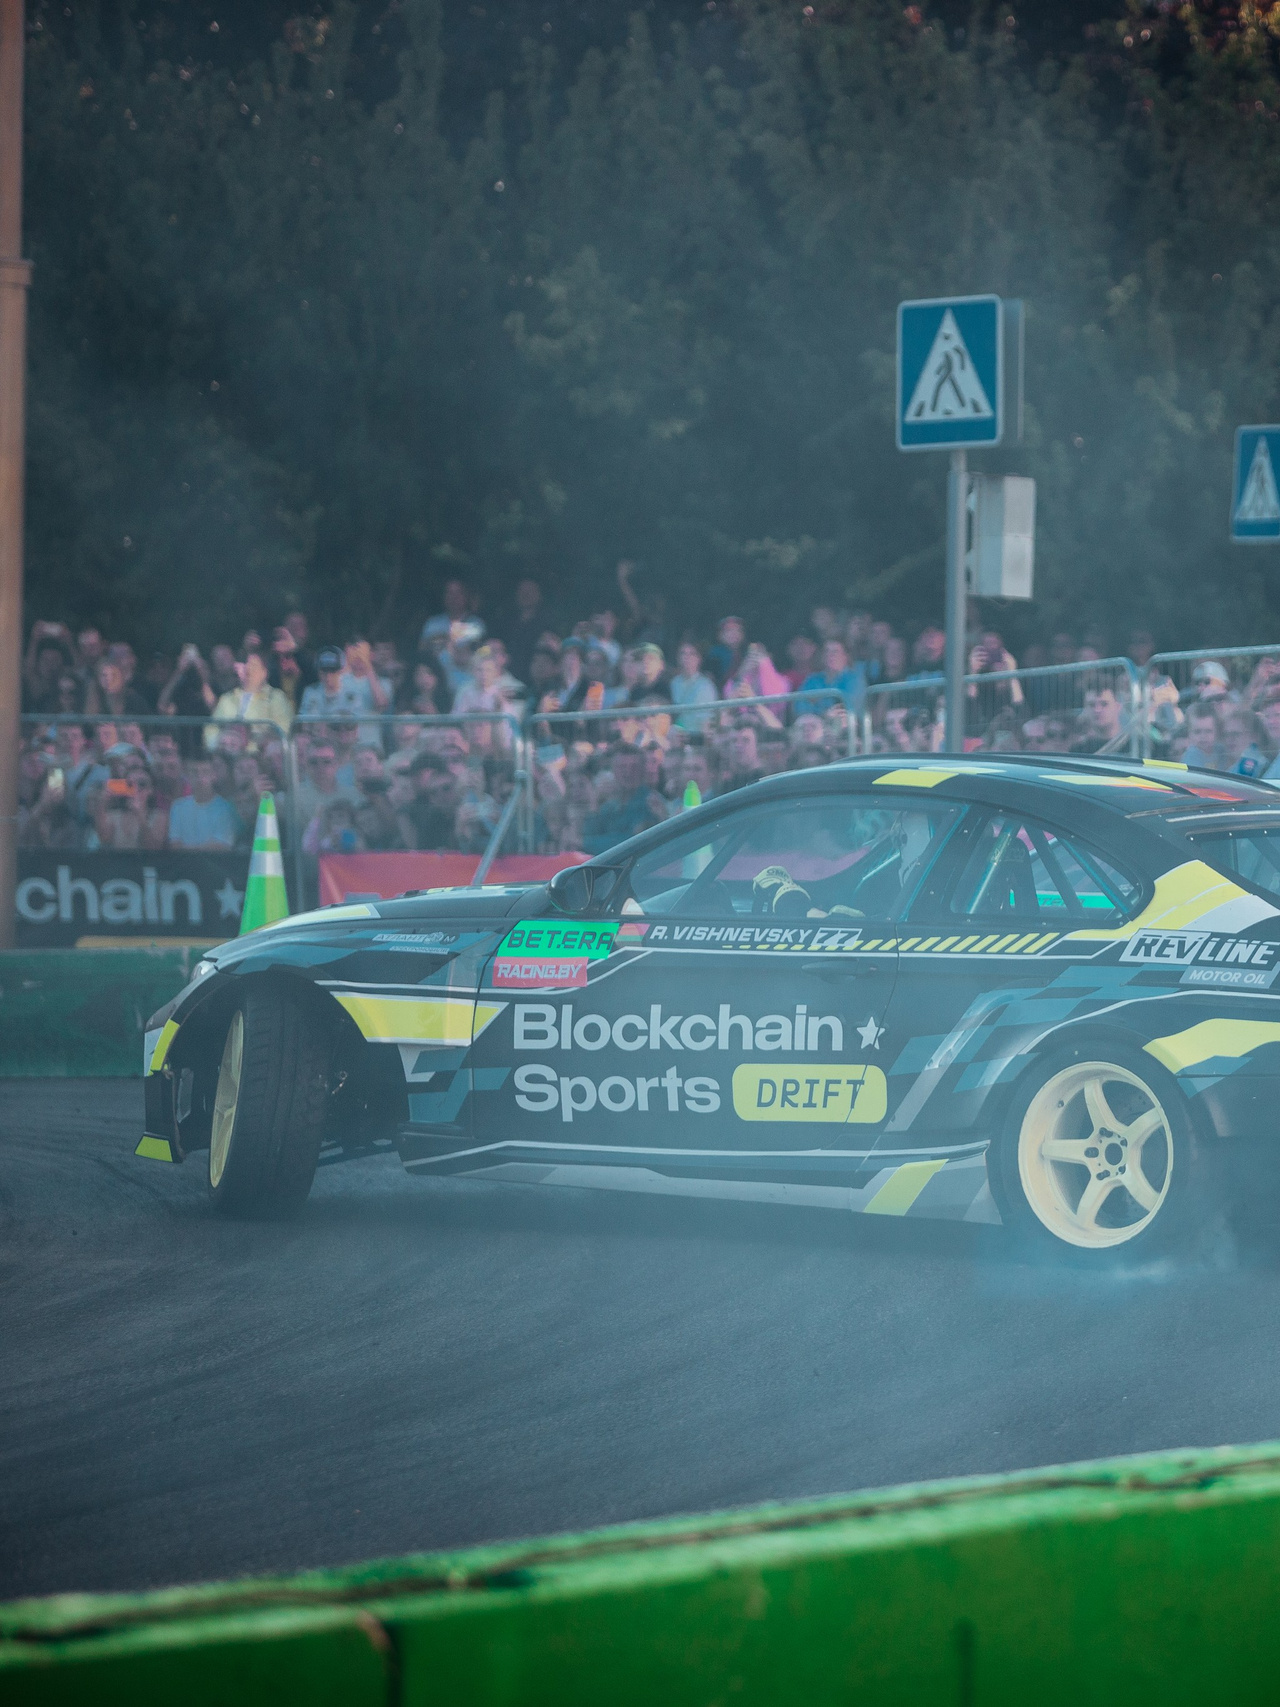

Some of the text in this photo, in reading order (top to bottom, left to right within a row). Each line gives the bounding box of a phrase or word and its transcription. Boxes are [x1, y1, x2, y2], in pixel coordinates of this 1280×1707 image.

[497, 964, 582, 979] RACING.BY
[1189, 969, 1266, 985] MOTOR OIL
[513, 1003, 844, 1052] Blockchain
[514, 1063, 866, 1122] Sports DRIFT
